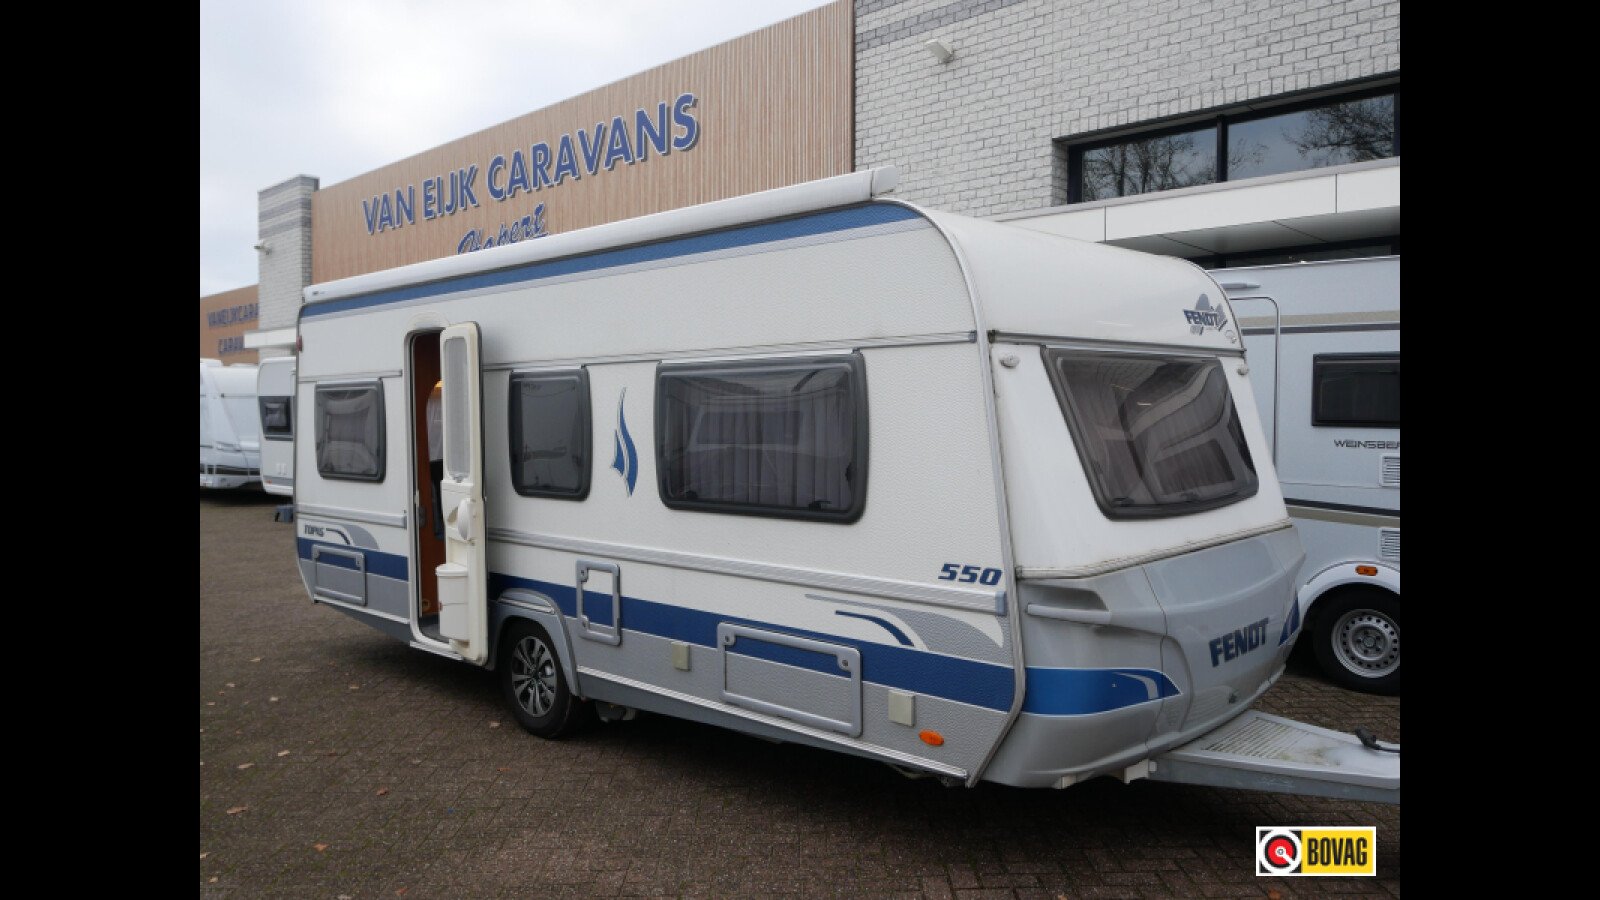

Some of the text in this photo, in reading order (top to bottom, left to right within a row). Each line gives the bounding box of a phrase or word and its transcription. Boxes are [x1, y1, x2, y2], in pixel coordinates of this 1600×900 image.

[363, 92, 698, 235] VAN EIJK CARAVANS
[1183, 309, 1218, 327] FENDT
[938, 563, 1002, 585] 550
[1209, 617, 1269, 668] FENDT
